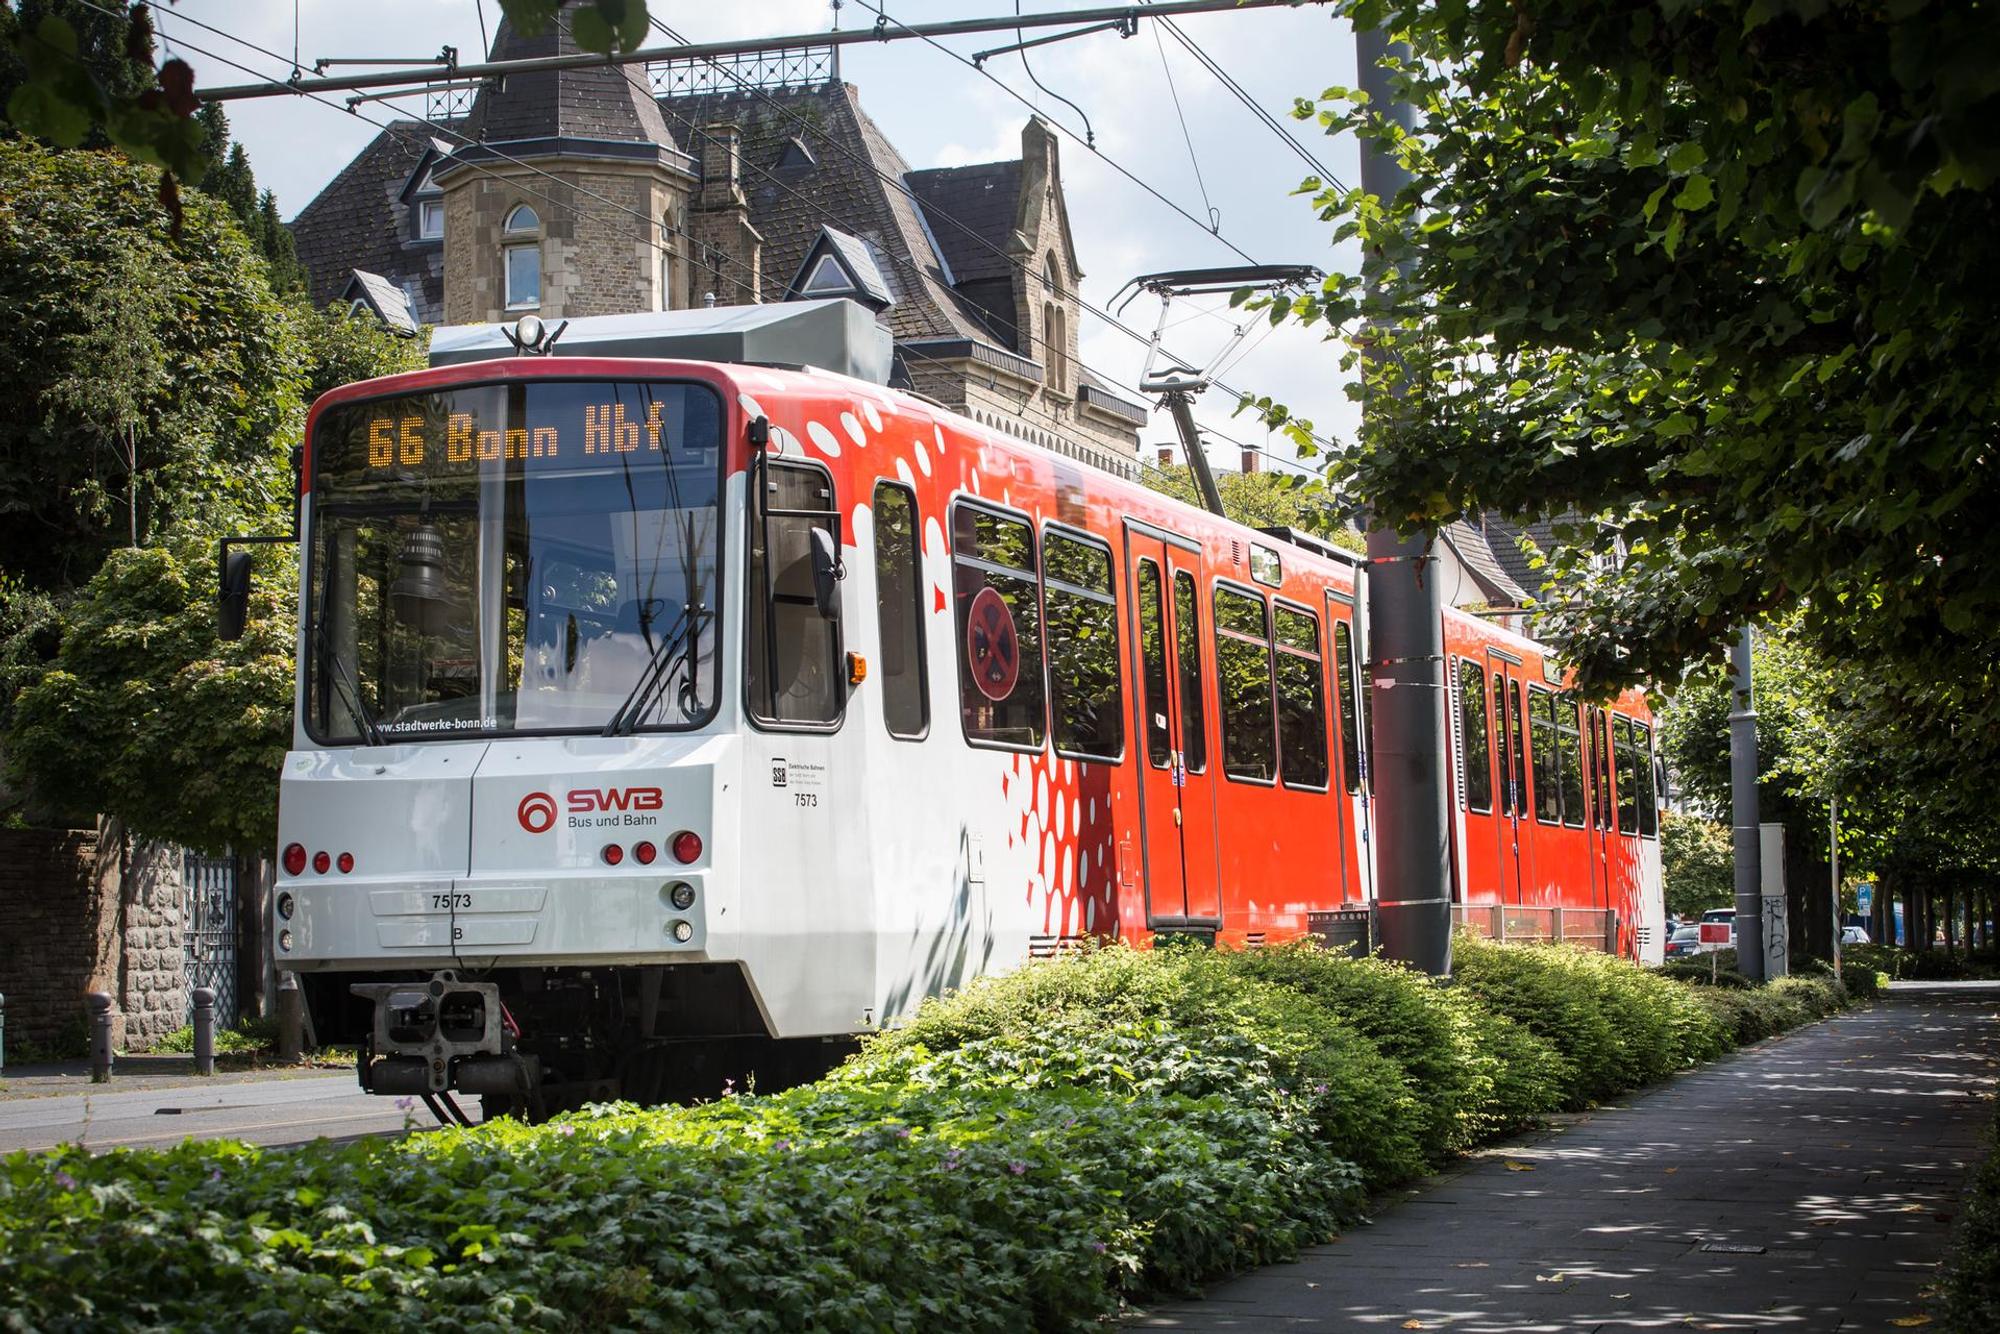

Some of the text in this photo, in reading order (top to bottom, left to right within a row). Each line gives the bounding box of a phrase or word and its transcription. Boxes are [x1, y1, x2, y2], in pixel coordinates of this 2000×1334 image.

[369, 400, 665, 467] 66 Bonn Hbf
[567, 787, 664, 813] SWB
[795, 793, 818, 807] 7573
[568, 814, 657, 828] Bus und Bahn
[432, 894, 472, 909] 7573
[453, 928, 463, 940] B
